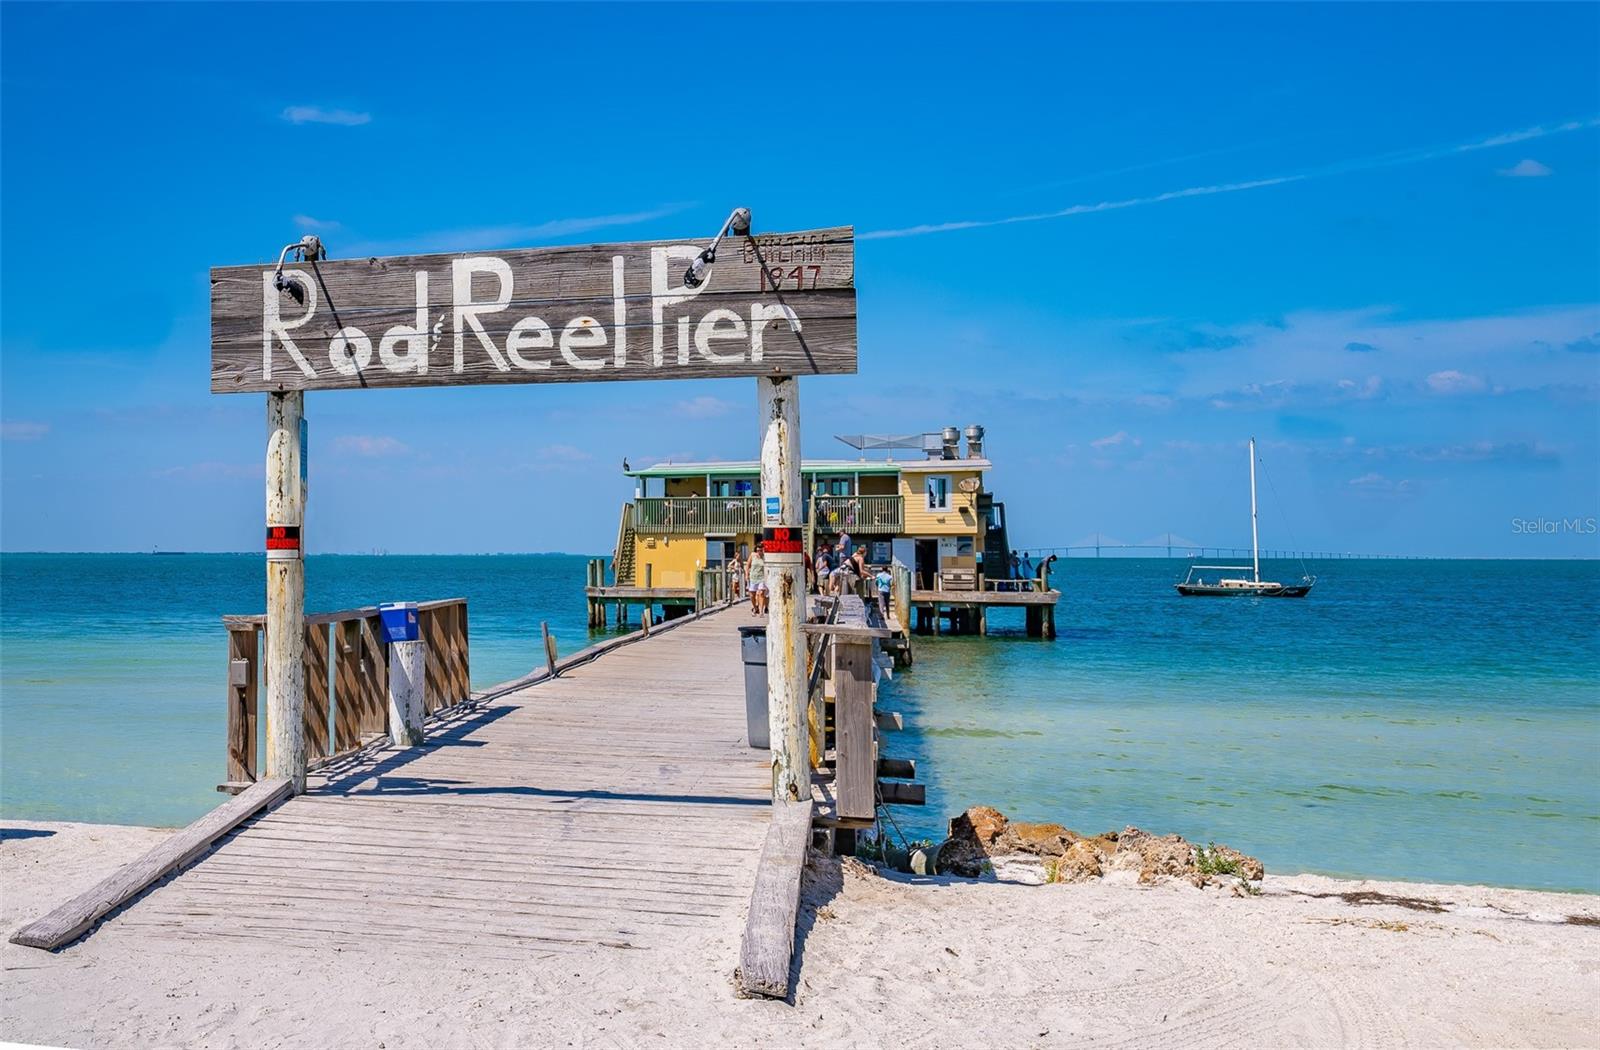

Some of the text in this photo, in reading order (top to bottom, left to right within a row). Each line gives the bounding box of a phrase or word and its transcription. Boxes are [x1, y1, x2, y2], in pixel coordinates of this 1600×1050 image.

[761, 265, 821, 292] 1947
[262, 269, 429, 381] Rod
[452, 256, 627, 374] Reel
[651, 245, 802, 368] Pier
[273, 527, 286, 538] NO
[774, 528, 790, 540] NO
